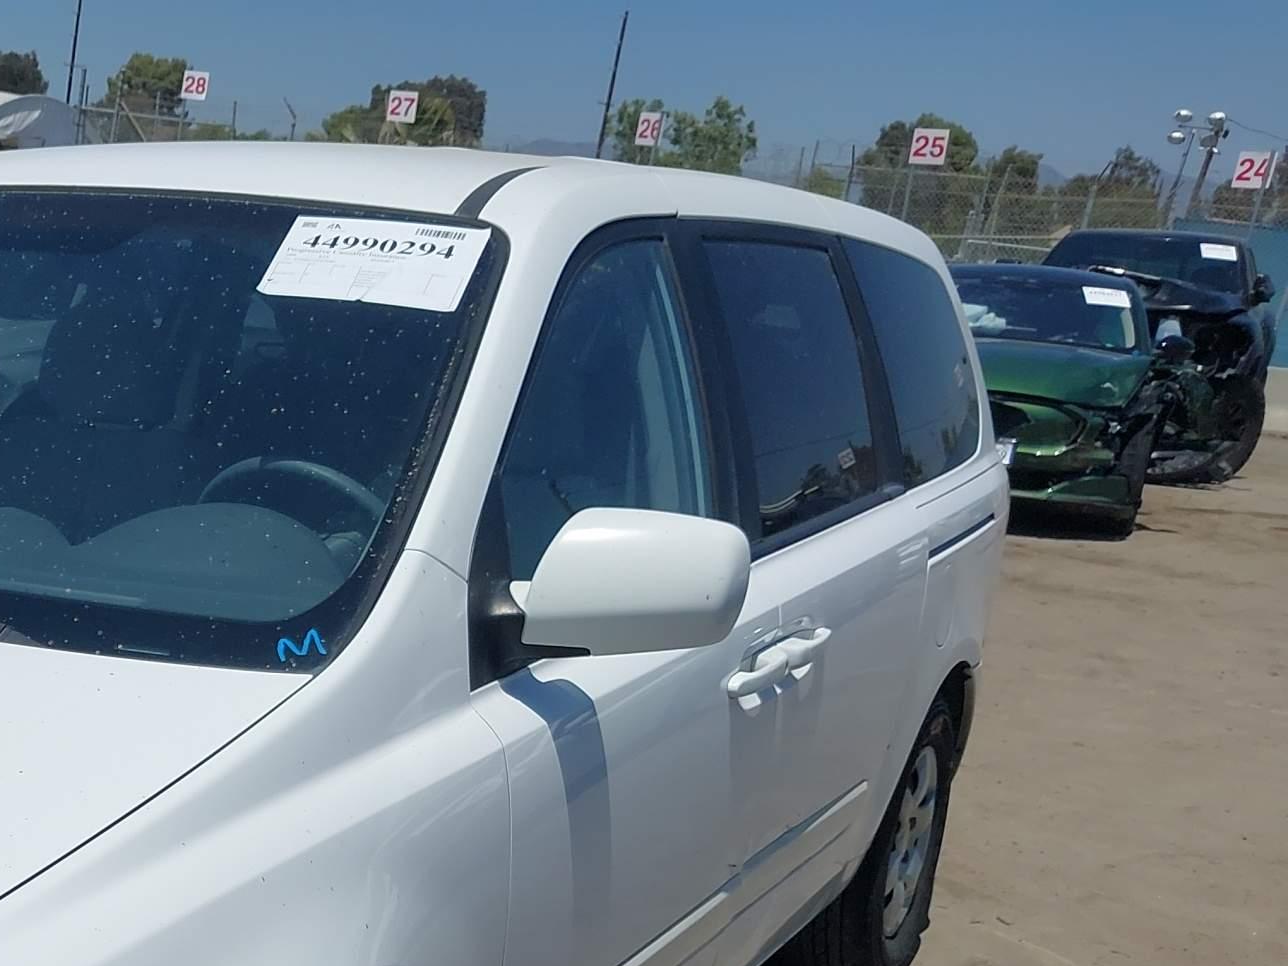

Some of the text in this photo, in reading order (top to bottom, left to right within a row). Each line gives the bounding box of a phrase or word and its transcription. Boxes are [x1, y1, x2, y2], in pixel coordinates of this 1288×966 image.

[184, 75, 207, 95] 28
[390, 95, 416, 117] 27
[638, 118, 660, 141] 26
[912, 135, 945, 158] 25
[1235, 158, 1268, 182] 24
[302, 233, 456, 260] 44990294
[277, 628, 328, 663] M
